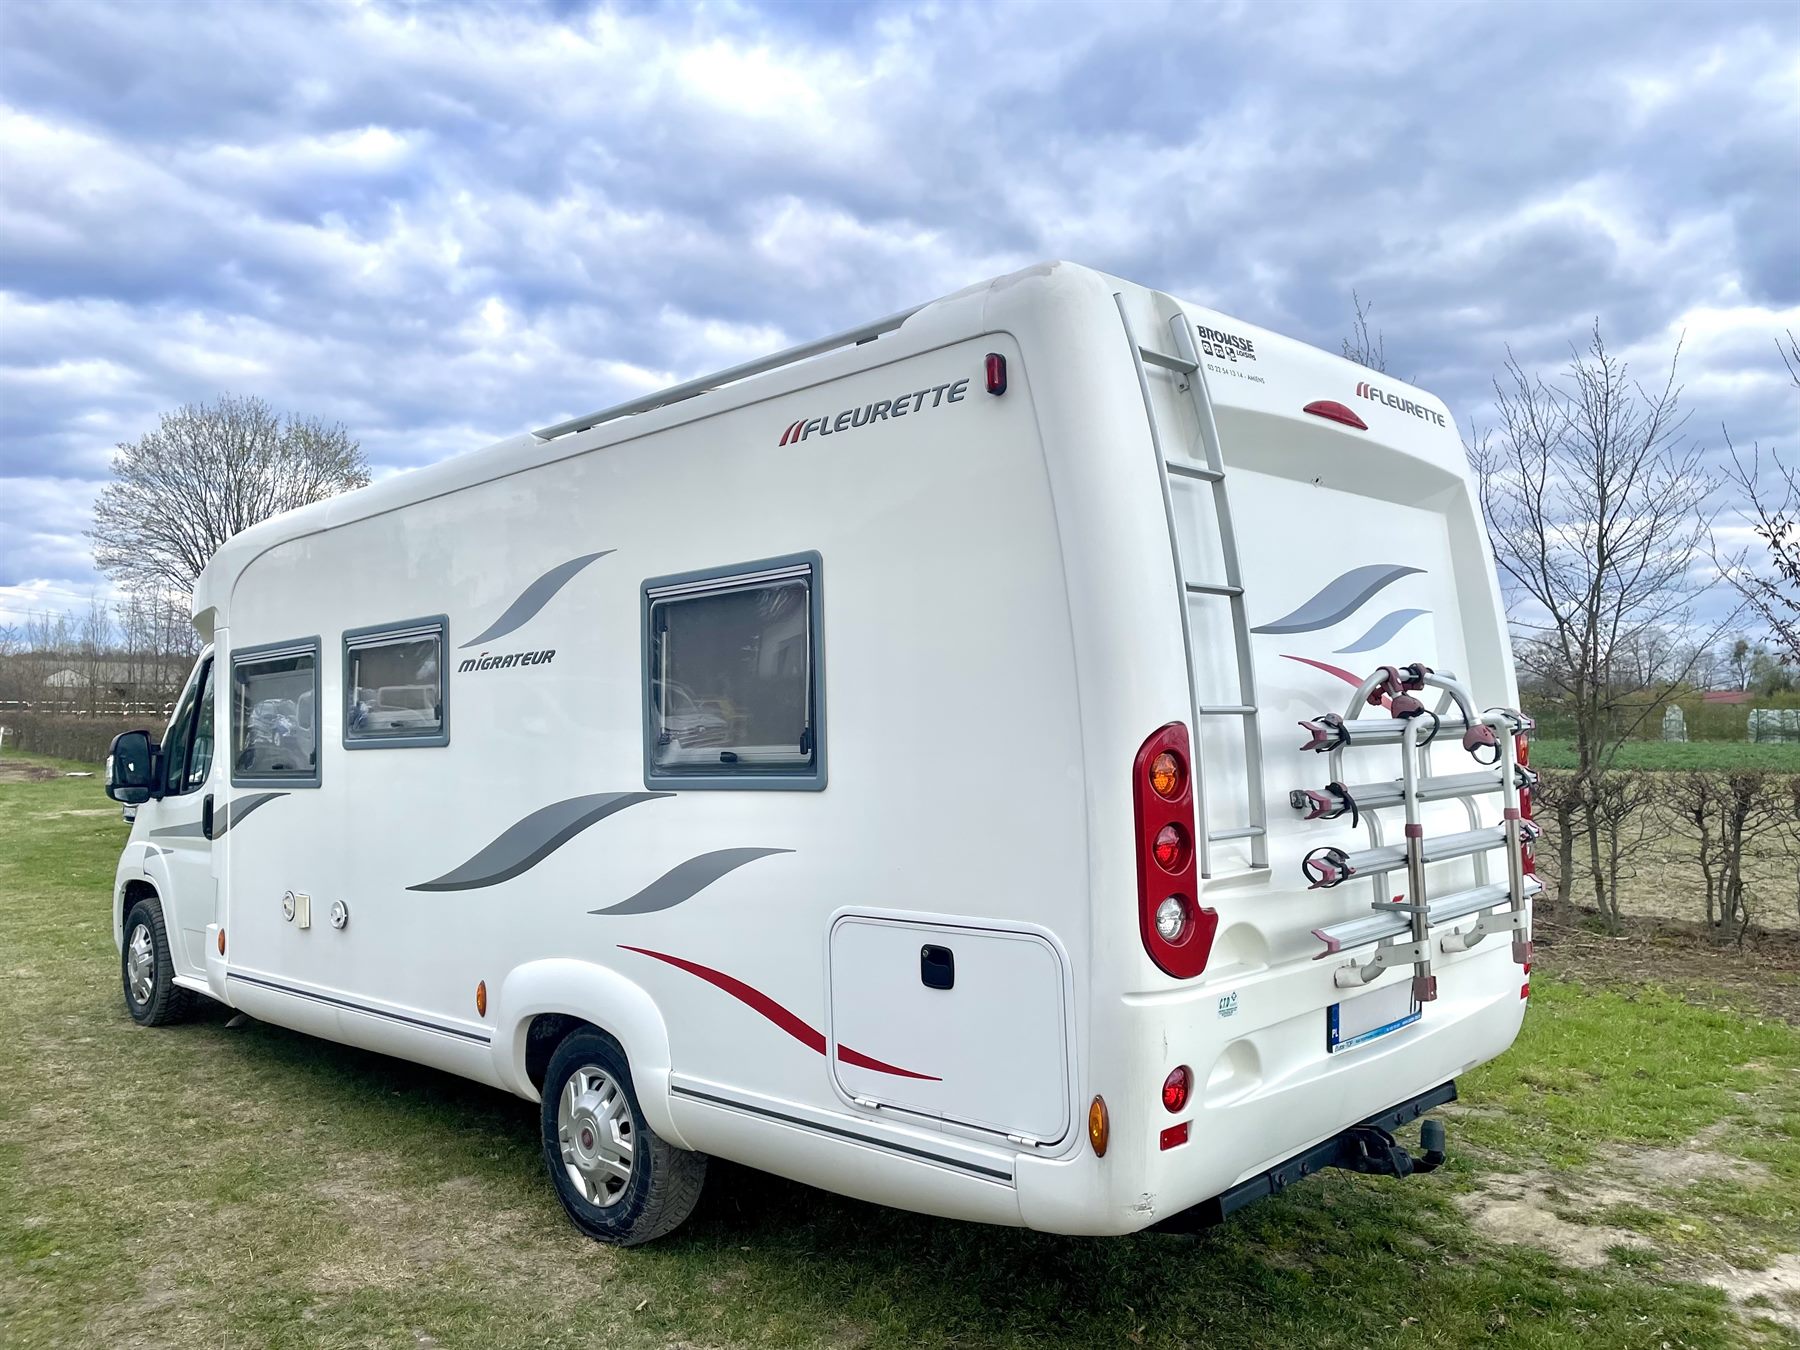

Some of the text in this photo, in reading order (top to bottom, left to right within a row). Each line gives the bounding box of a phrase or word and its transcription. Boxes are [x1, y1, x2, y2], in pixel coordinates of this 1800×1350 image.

[1197, 325, 1254, 352] BROUSSE
[801, 378, 970, 442] FLEURETTE
[1369, 387, 1446, 428] FLEURETTE
